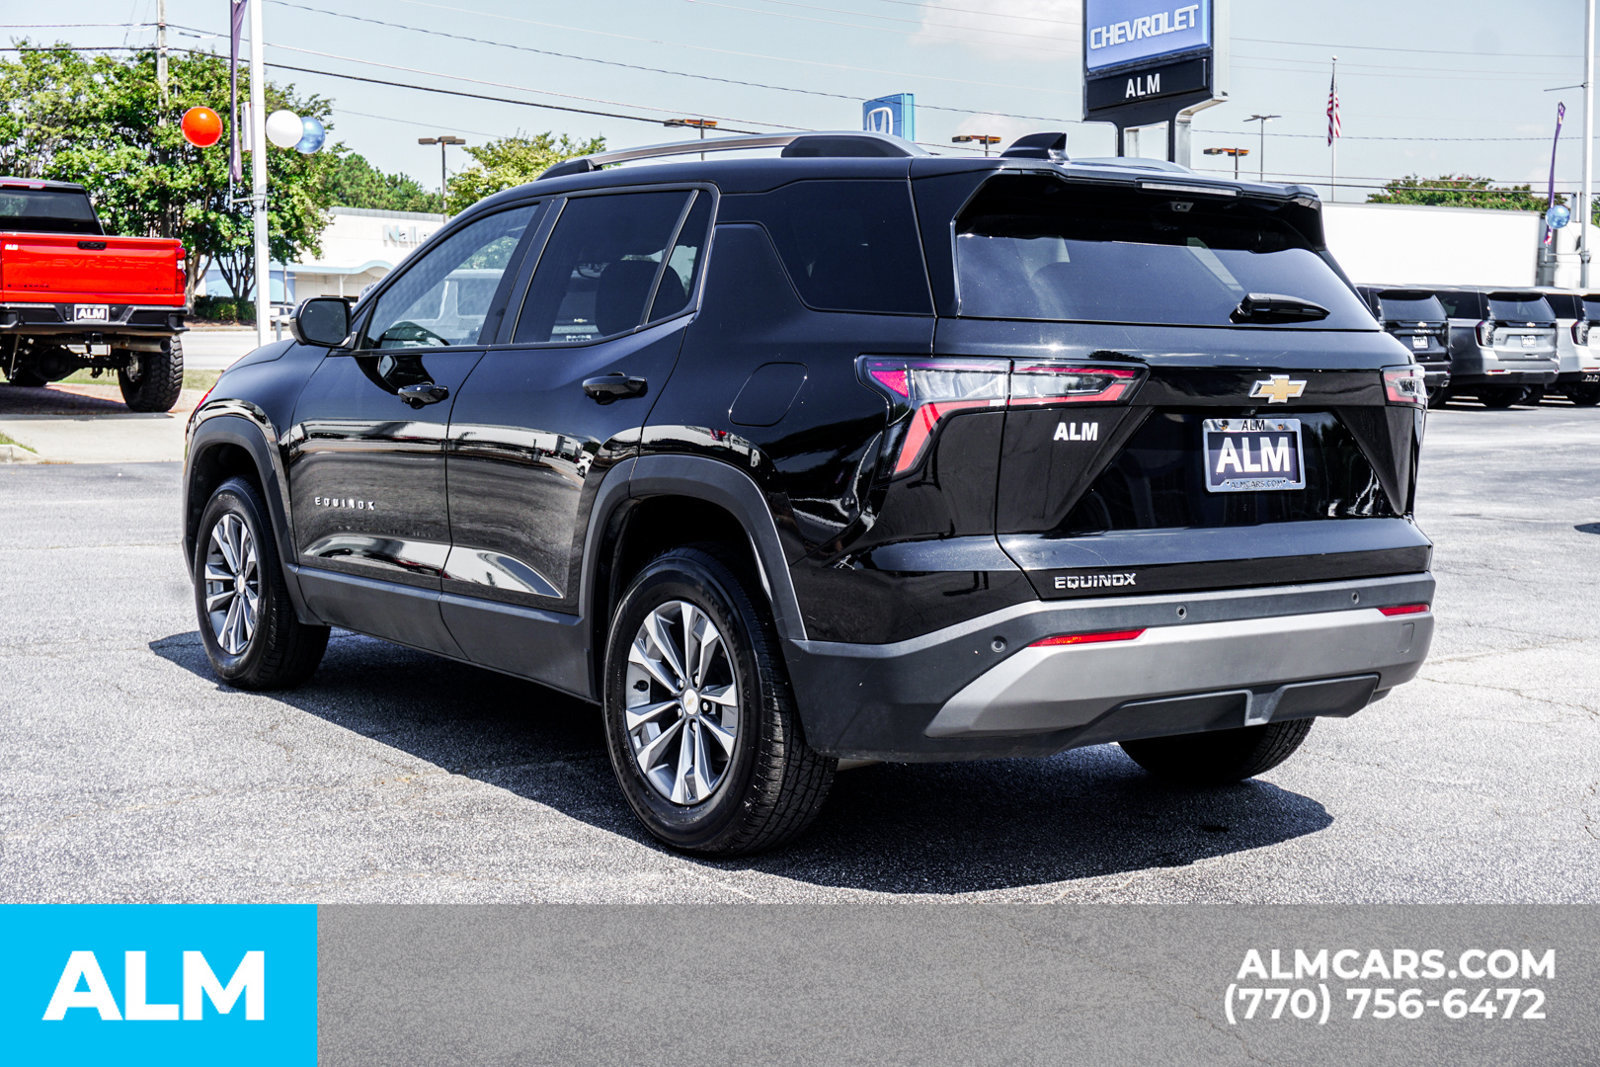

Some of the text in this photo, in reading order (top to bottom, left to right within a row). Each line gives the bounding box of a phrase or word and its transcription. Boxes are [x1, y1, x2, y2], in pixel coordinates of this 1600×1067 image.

[1090, 4, 1199, 50] CHEVROLET
[1125, 73, 1161, 98] ALM
[77, 308, 105, 319] ALM
[1053, 422, 1098, 441] ALM
[1241, 420, 1266, 431] ALM
[1215, 436, 1291, 473] ALM
[314, 496, 376, 511] EQUINOX
[1054, 572, 1137, 590] EQUINOX
